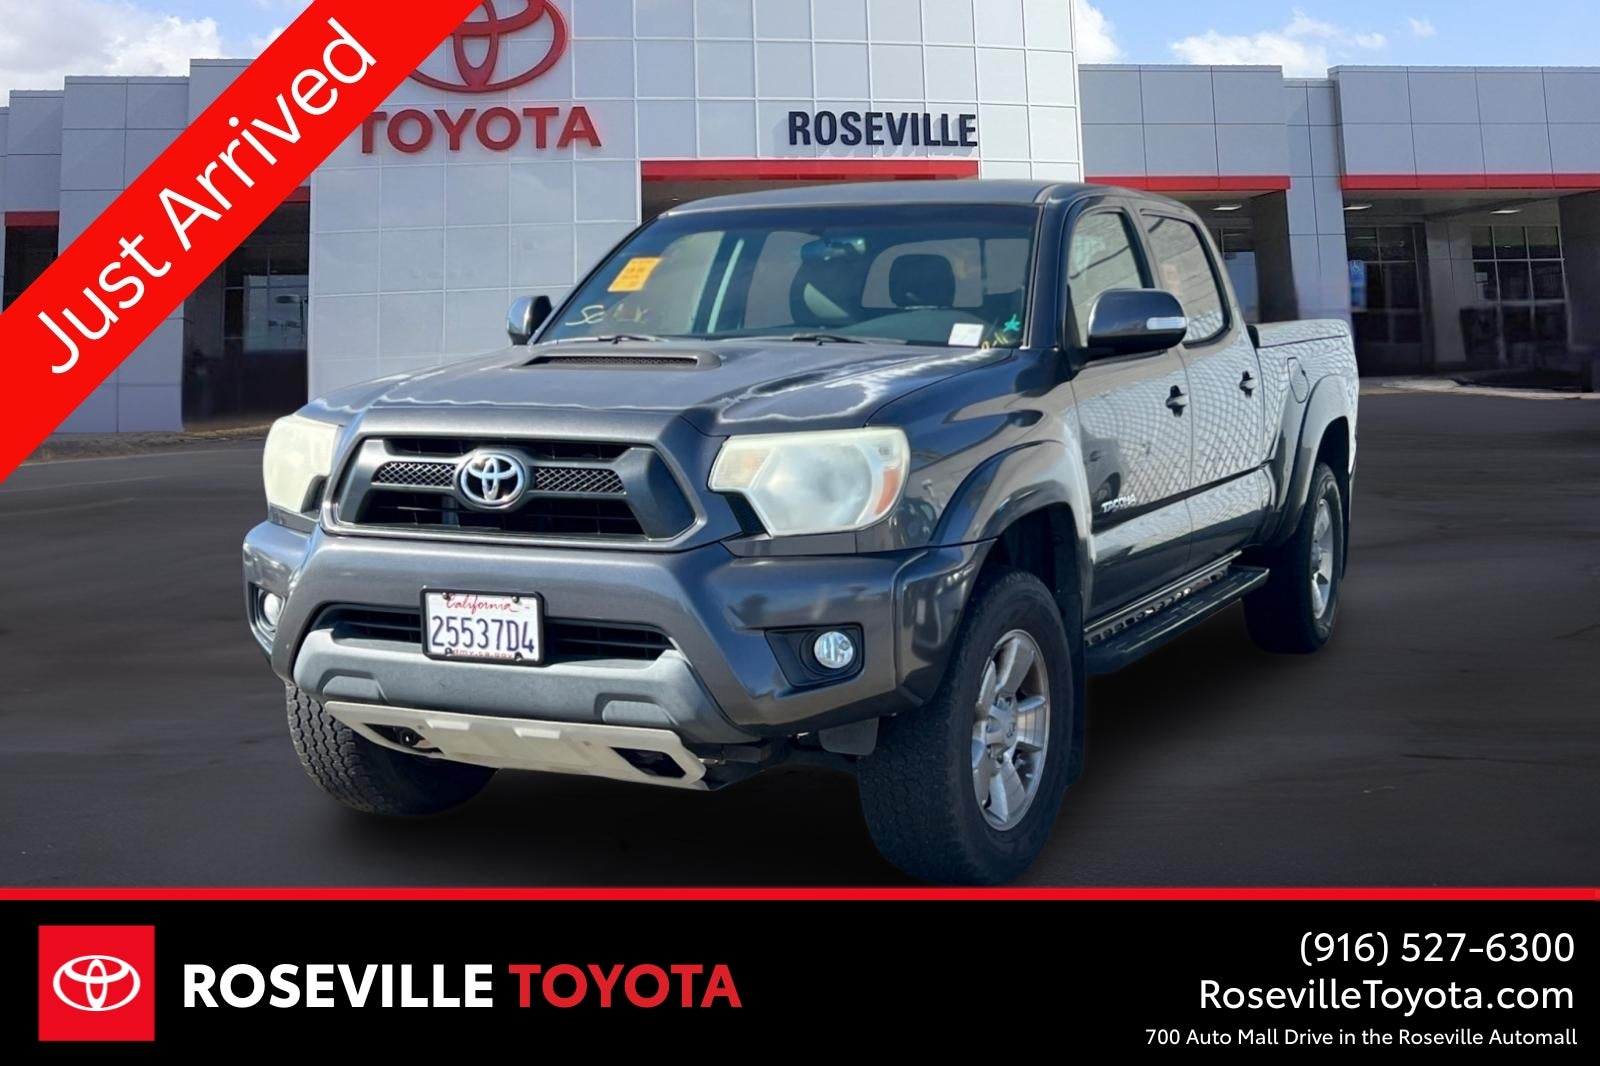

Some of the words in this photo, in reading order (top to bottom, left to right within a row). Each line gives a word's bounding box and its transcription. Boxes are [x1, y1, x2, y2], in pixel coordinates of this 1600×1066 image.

[362, 106, 601, 154] TOYOTA
[788, 110, 978, 147] ROSEVILLE
[446, 592, 520, 614] California
[431, 614, 535, 653] 25537D4
